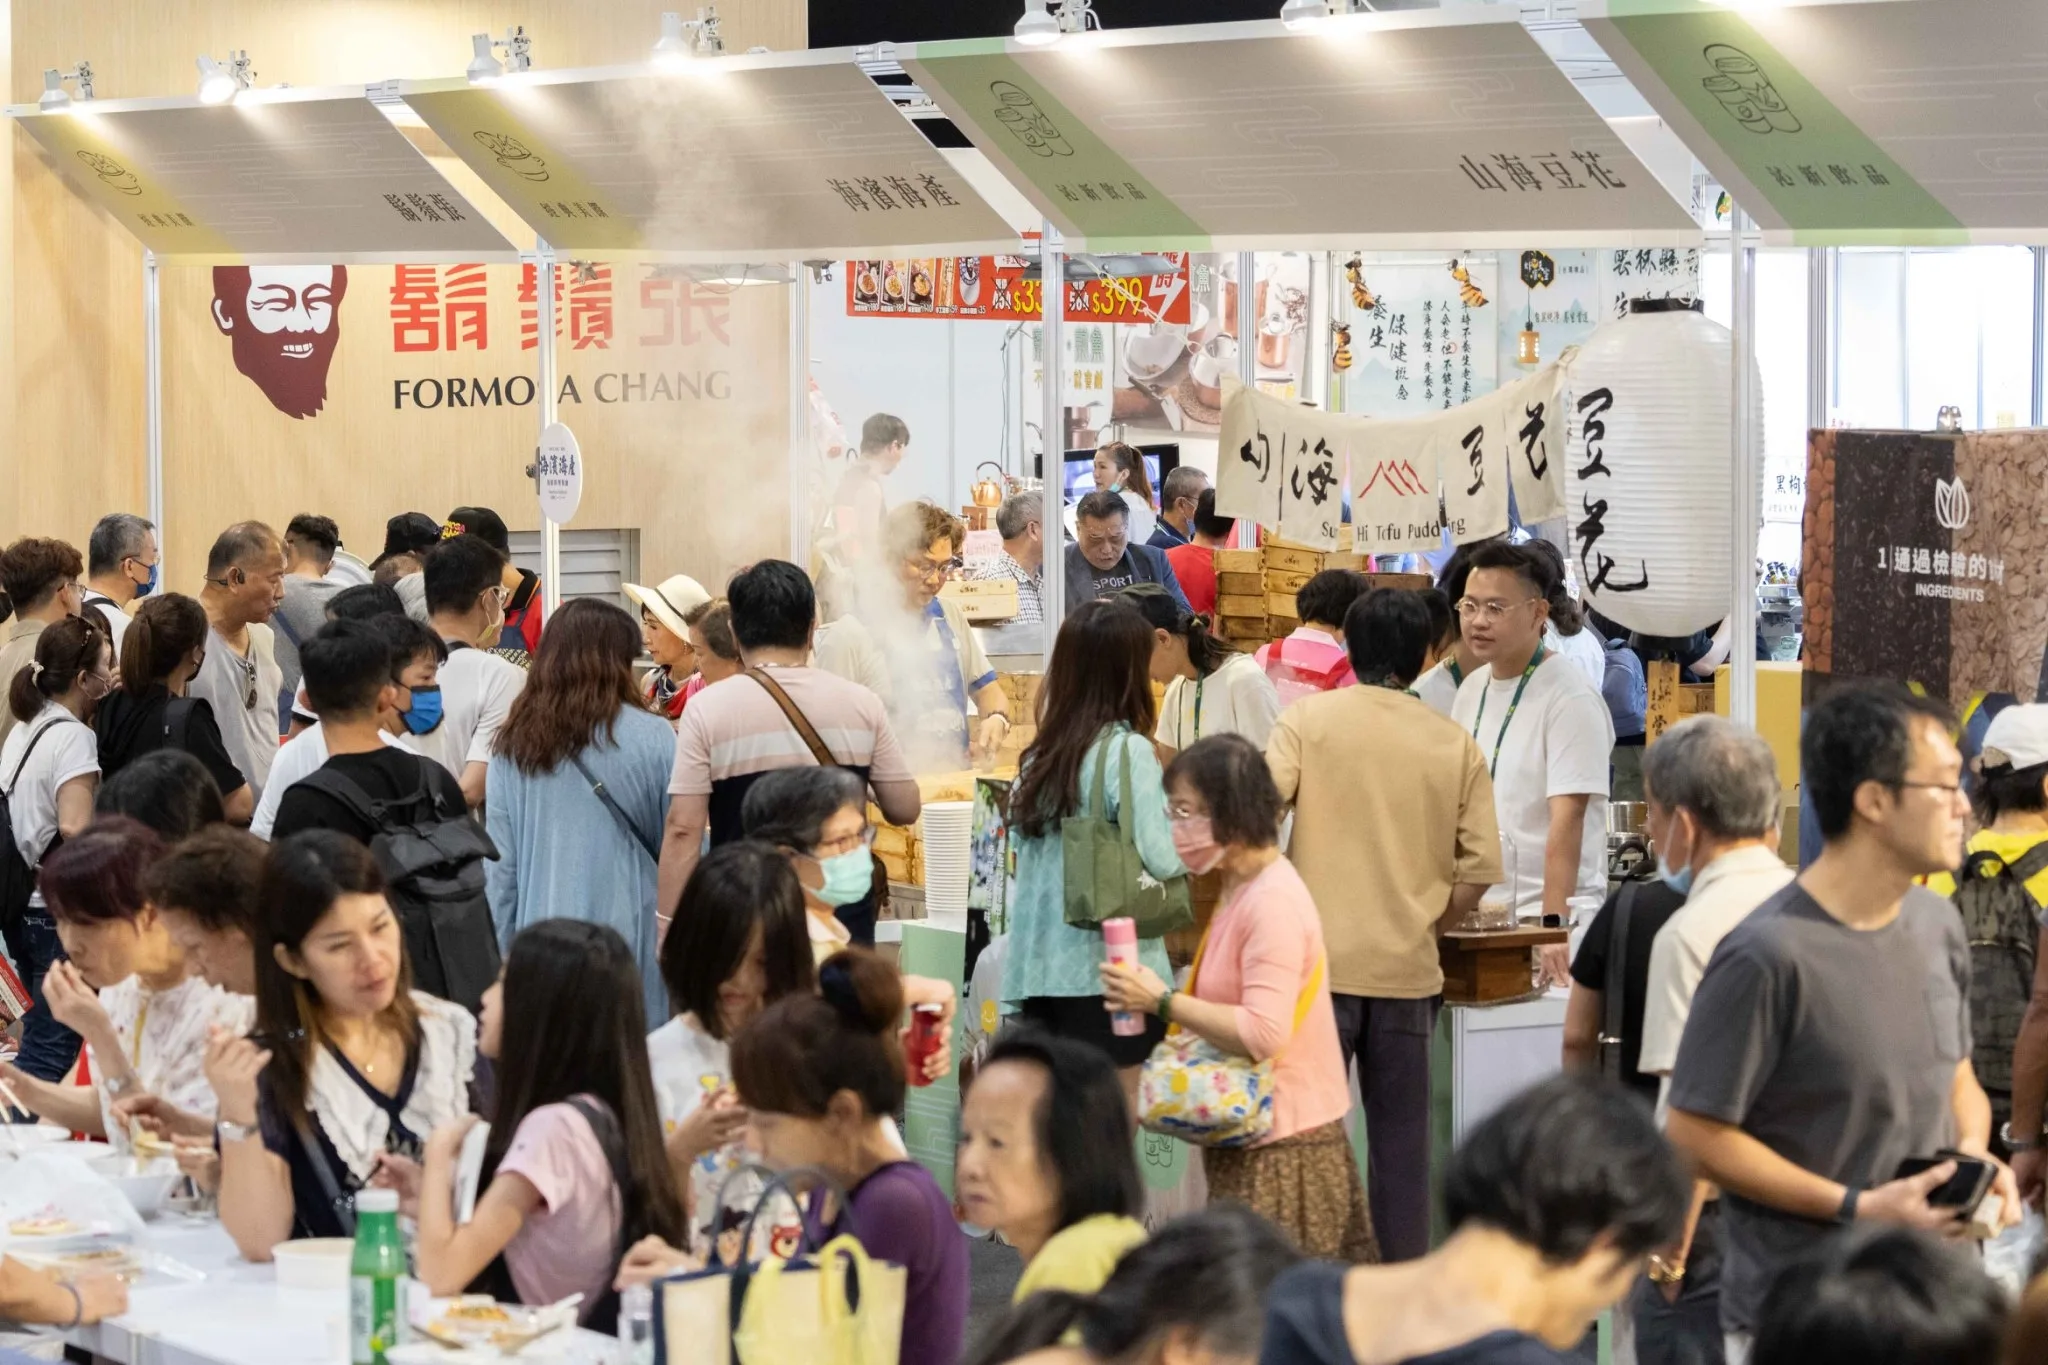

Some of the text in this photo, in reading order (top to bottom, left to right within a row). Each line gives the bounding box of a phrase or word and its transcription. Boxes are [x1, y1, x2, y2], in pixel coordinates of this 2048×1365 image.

[1459, 151, 1627, 192] 山海豆花
[384, 193, 466, 222] 鬍鬚張
[826, 173, 960, 211] 海濱海產
[1092, 277, 1143, 316] $399
[1388, 314, 1409, 401] 保健概念
[394, 370, 732, 410] FORMOA CHANG
[1576, 387, 1649, 597] 豆花
[1775, 474, 1807, 496] 黑枸
[1357, 524, 1369, 542] Hi
[1877, 546, 1888, 569] 1
[1915, 583, 1985, 603] INGREDIENTS
